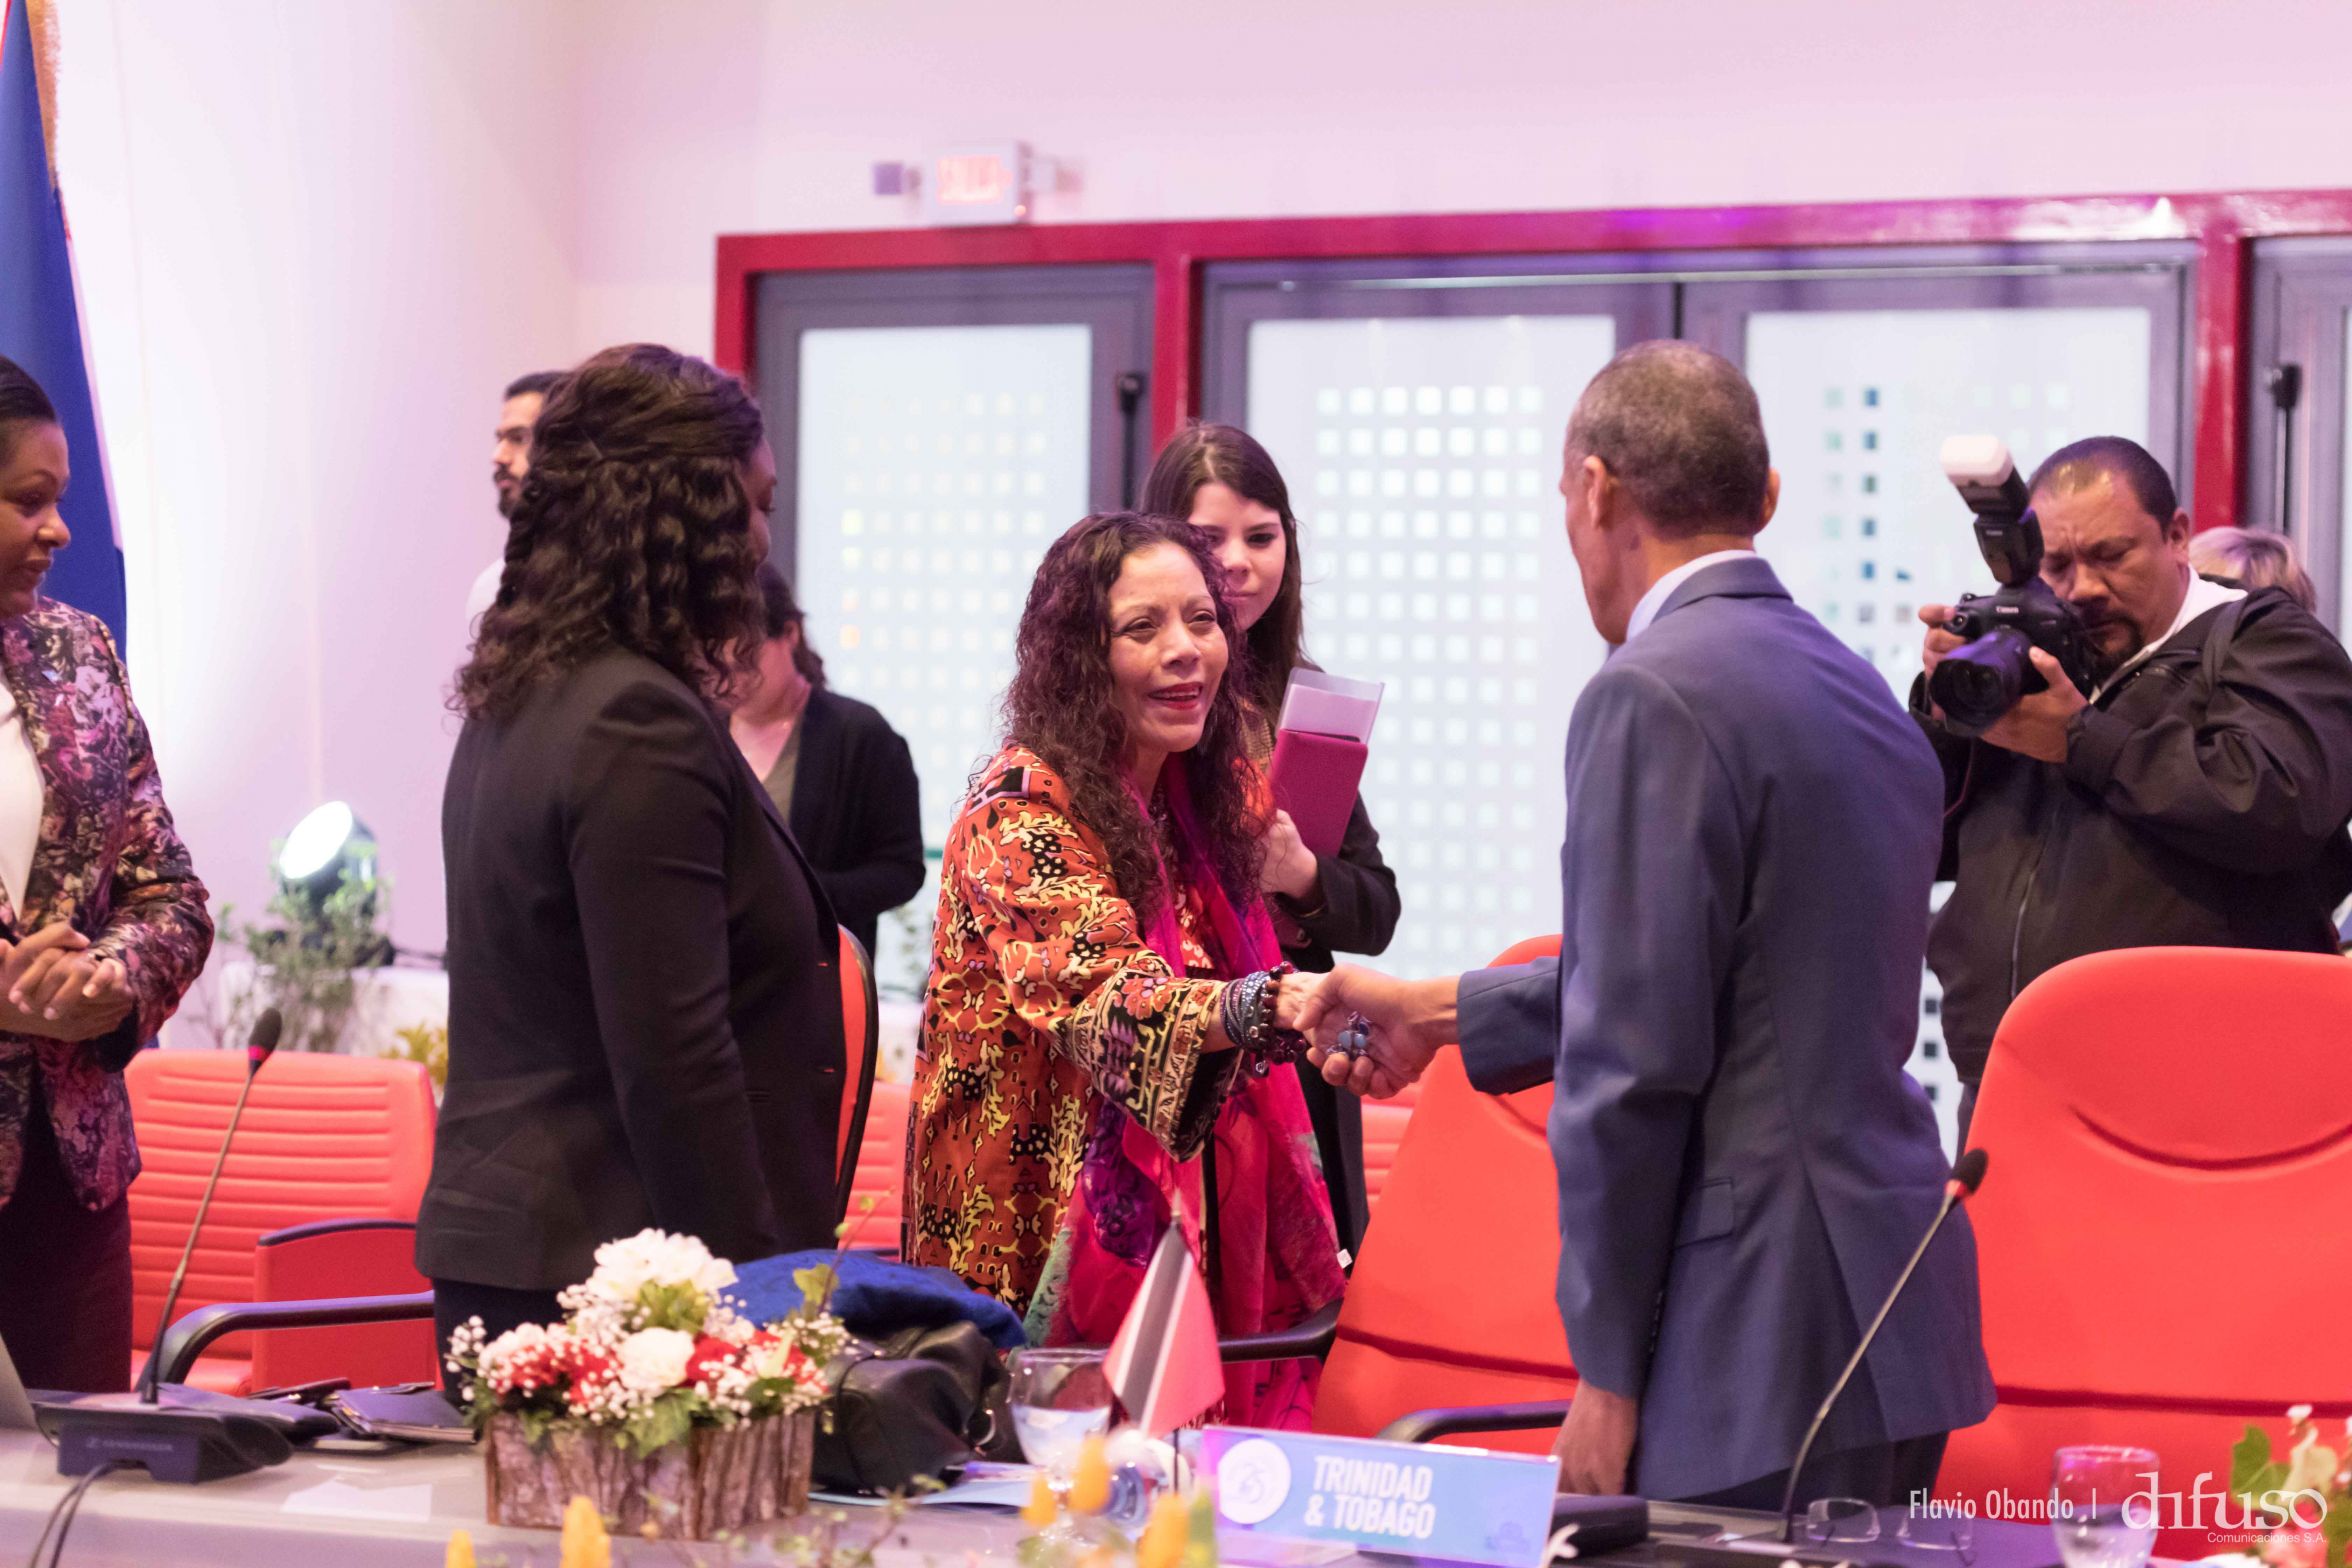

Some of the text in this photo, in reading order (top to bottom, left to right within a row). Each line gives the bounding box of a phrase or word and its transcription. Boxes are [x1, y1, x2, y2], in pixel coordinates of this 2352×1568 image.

[1314, 1455, 1432, 1502] TRINIDAD
[1304, 1494, 1436, 1538] & TOBAGO
